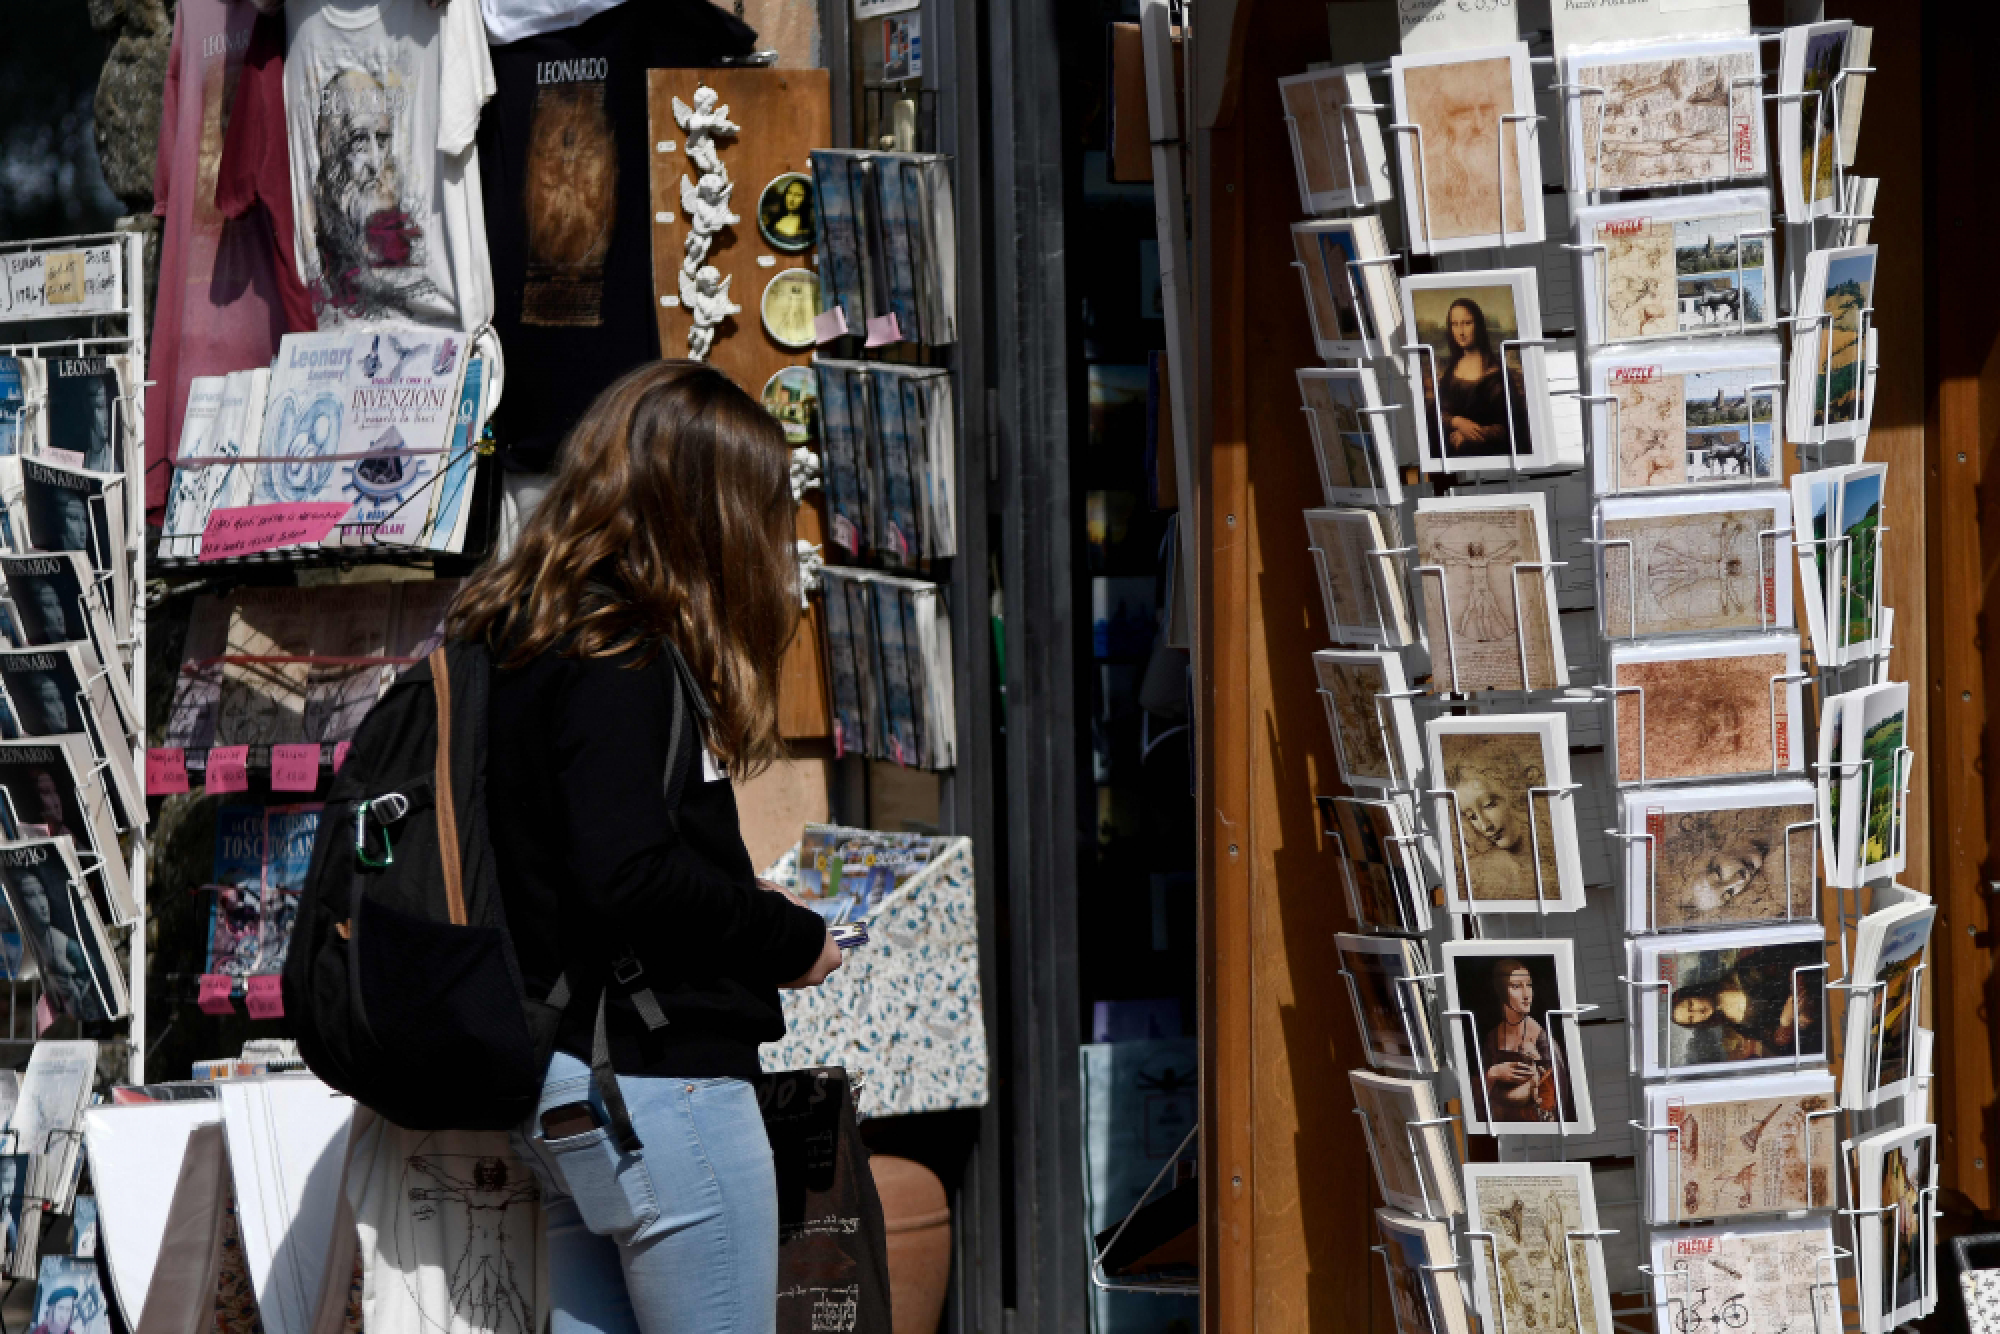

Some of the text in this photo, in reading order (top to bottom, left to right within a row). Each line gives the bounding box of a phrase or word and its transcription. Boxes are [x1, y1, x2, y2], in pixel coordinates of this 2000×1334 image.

[536, 57, 608, 84] LEONARDO
[1737, 124, 1752, 163] PUZZLE
[1604, 218, 1644, 235] PUZZLE
[1615, 365, 1655, 380] PUZZLE
[352, 387, 448, 408] INVENZIONI
[1776, 721, 1789, 760] PUZZLE
[1677, 1237, 1714, 1256] PUZZLE
